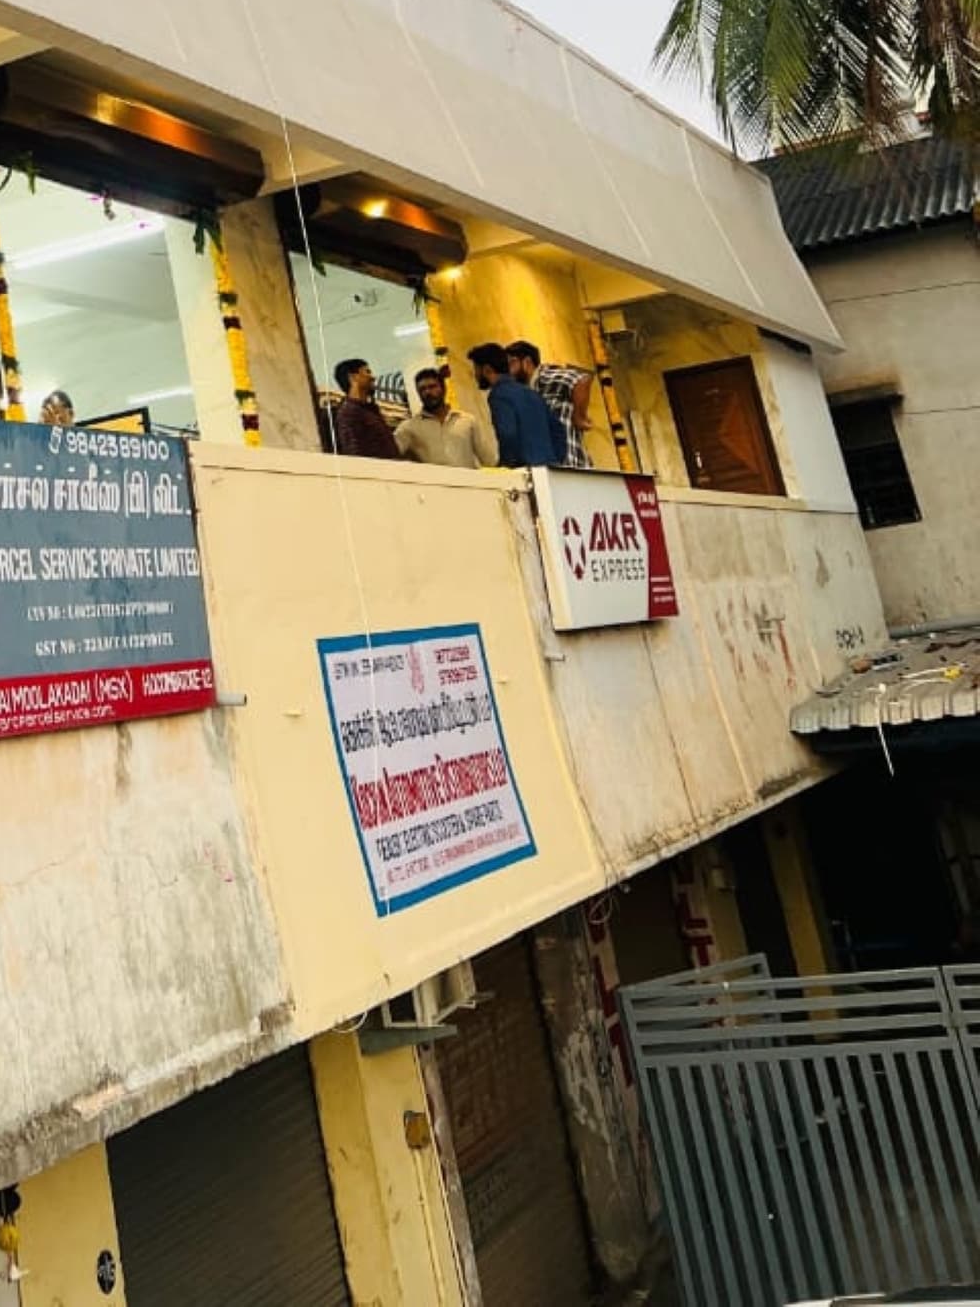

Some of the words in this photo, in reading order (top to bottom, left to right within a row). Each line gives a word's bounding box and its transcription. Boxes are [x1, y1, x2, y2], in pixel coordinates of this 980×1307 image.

[588, 512, 640, 551] AKR
[40, 548, 99, 581] SERVICE
[101, 547, 153, 579] PRIVATE
[154, 548, 202, 578] LIMITED
[591, 558, 645, 582] EXPRESS
